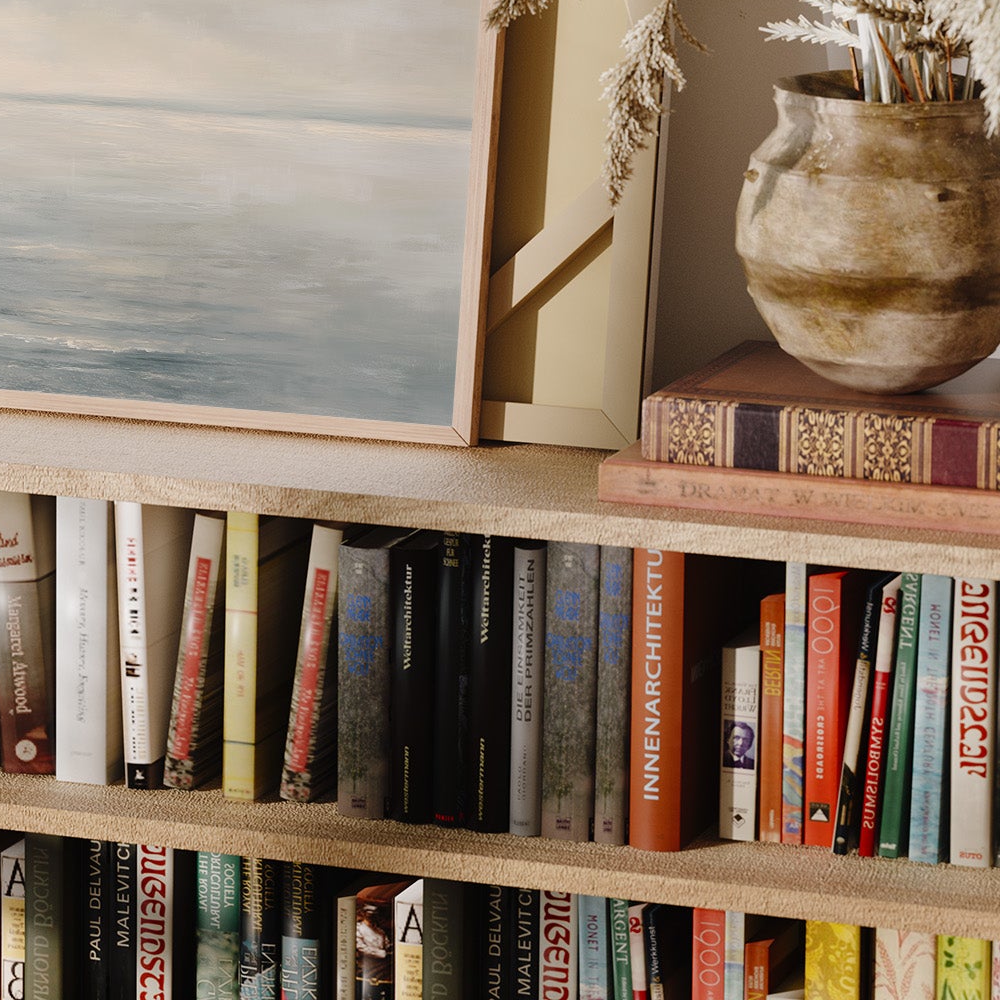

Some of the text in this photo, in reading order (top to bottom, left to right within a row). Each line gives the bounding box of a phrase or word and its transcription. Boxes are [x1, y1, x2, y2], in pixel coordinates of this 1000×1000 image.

[403, 564, 413, 670] Weltarchitektur
[480, 535, 491, 644] Weltarchitek
[516, 574, 525, 685] EINSAMKEIT
[6, 594, 32, 714] Margaret Atwood
[525, 559, 535, 722] DER PRIMZAHLEN
[643, 549, 663, 801] INNENARCHITEKTU
[402, 745, 410, 813] westermann
[477, 737, 485, 822] westermann
[89, 841, 102, 961] PAUL DELVAU
[489, 886, 502, 956] DELVAU
[587, 915, 598, 951] MONET
[613, 900, 628, 965] ARGENT
[648, 926, 659, 975] Werkkunst
[693, 921, 721, 987] 1900
